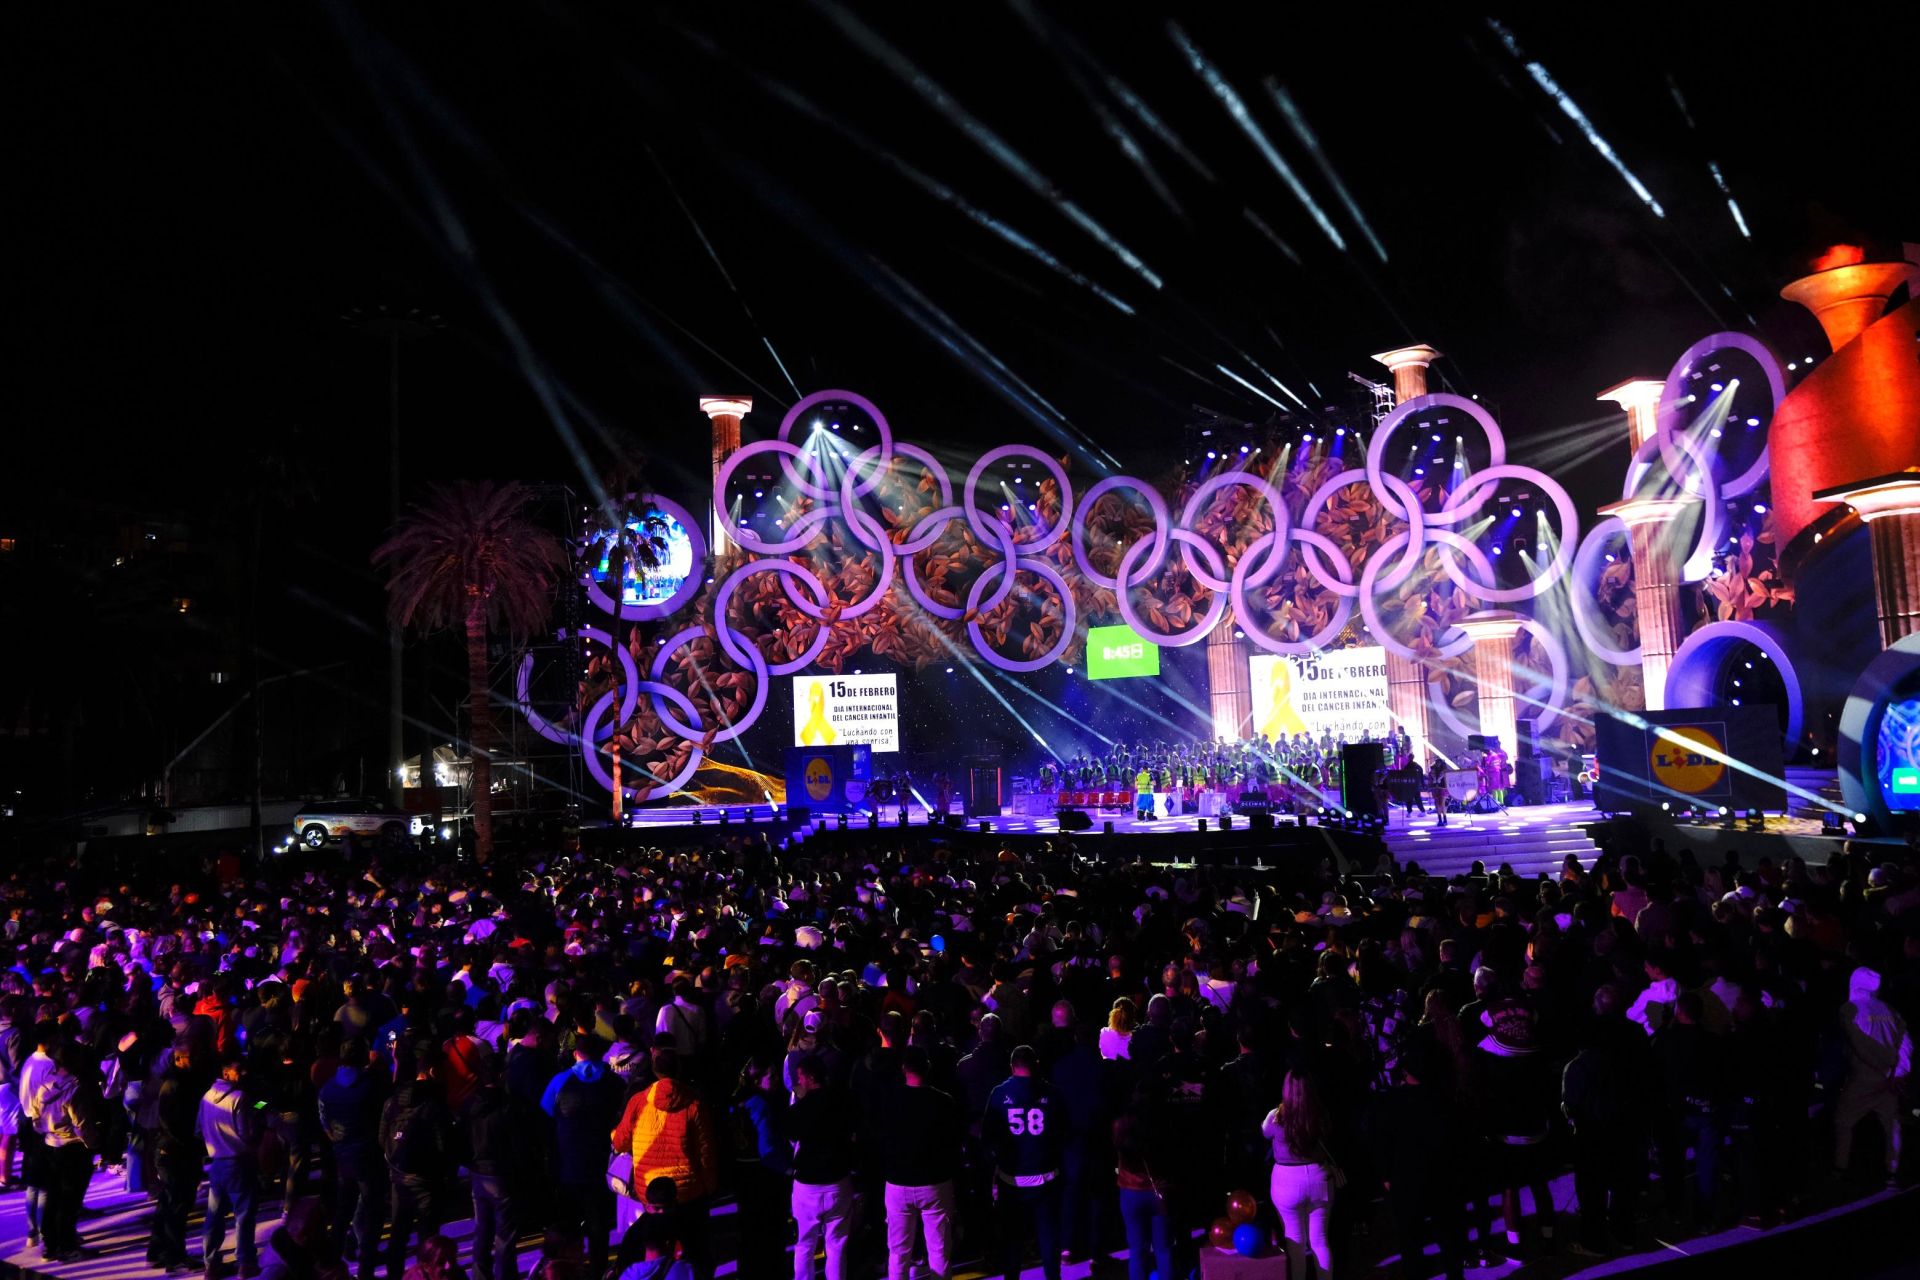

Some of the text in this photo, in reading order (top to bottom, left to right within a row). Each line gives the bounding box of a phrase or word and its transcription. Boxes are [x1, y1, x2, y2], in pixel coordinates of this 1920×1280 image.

[1296, 660, 1319, 681] 15
[1320, 668, 1334, 679] DE
[829, 681, 895, 698] 15 DE FEBRERO
[833, 704, 893, 713] DIA INTERNACIONAL
[1301, 703, 1315, 713] DEL
[1317, 701, 1350, 712] CANCER
[832, 712, 896, 722] DEL CANCER INFANTIL
[880, 728, 893, 736] con
[1007, 1108, 1044, 1135] 58
